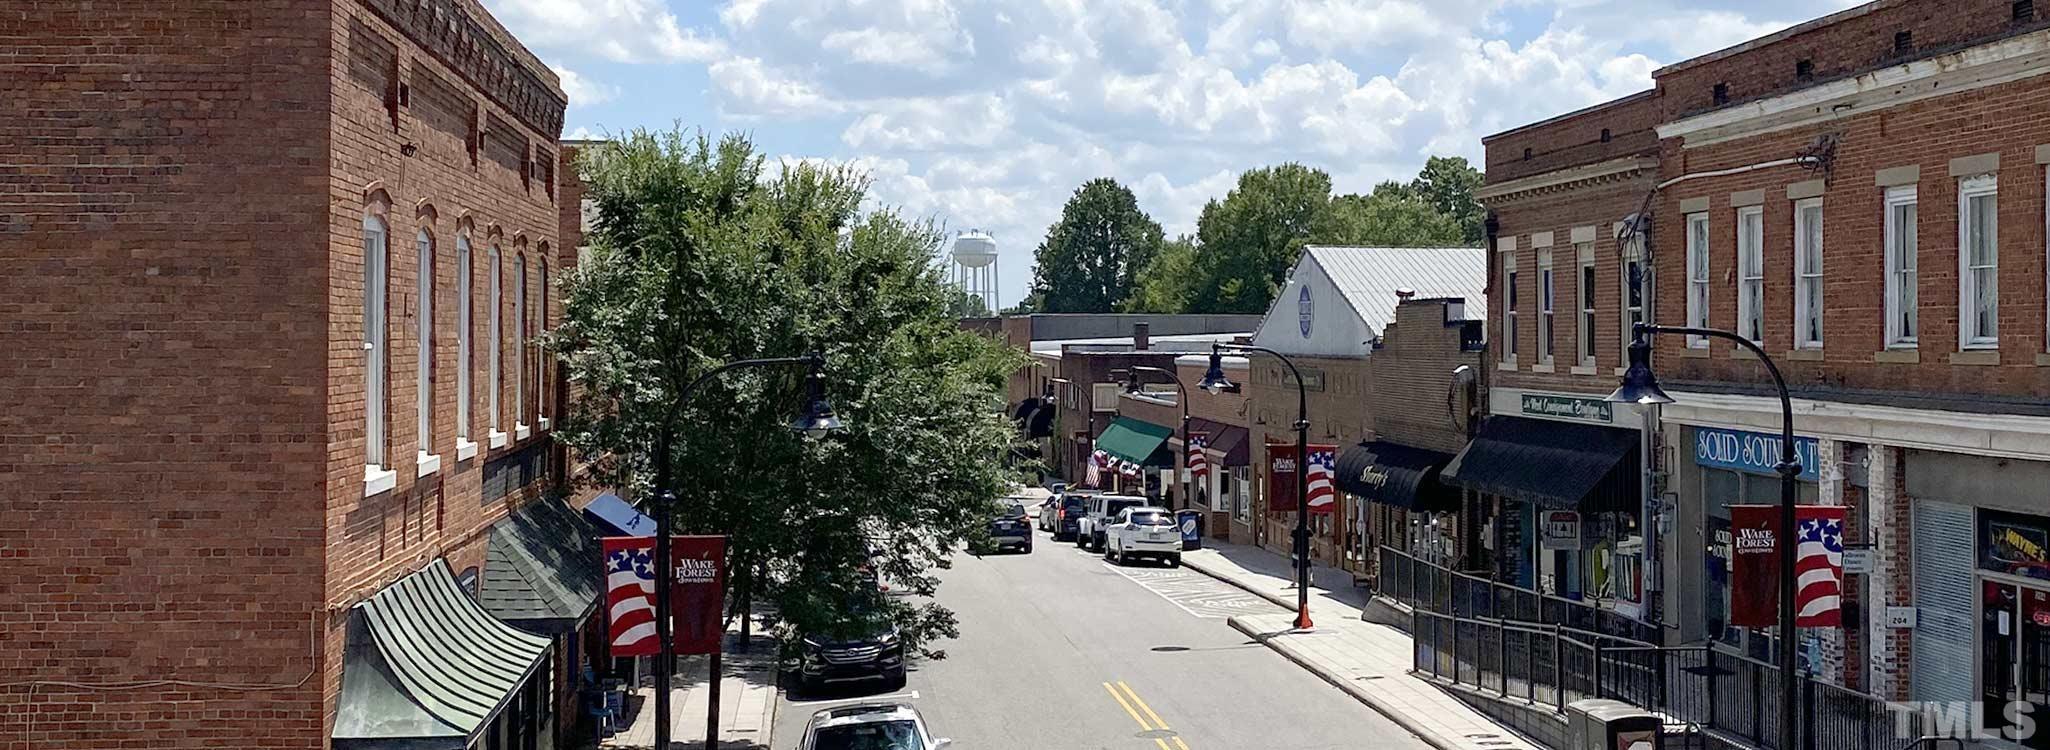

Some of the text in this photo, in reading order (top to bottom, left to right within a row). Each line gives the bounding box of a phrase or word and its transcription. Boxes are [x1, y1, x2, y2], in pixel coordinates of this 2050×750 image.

[1698, 430, 1739, 462] SOLID
[1743, 435, 1803, 468] SOUNS
[1740, 528, 1774, 539] WAKE
[1736, 537, 1776, 548] FOREST
[2006, 527, 2047, 563] WAYNE'S
[681, 558, 715, 569] WAKE
[675, 567, 718, 578] FOREST
[1892, 616, 1908, 625] 204
